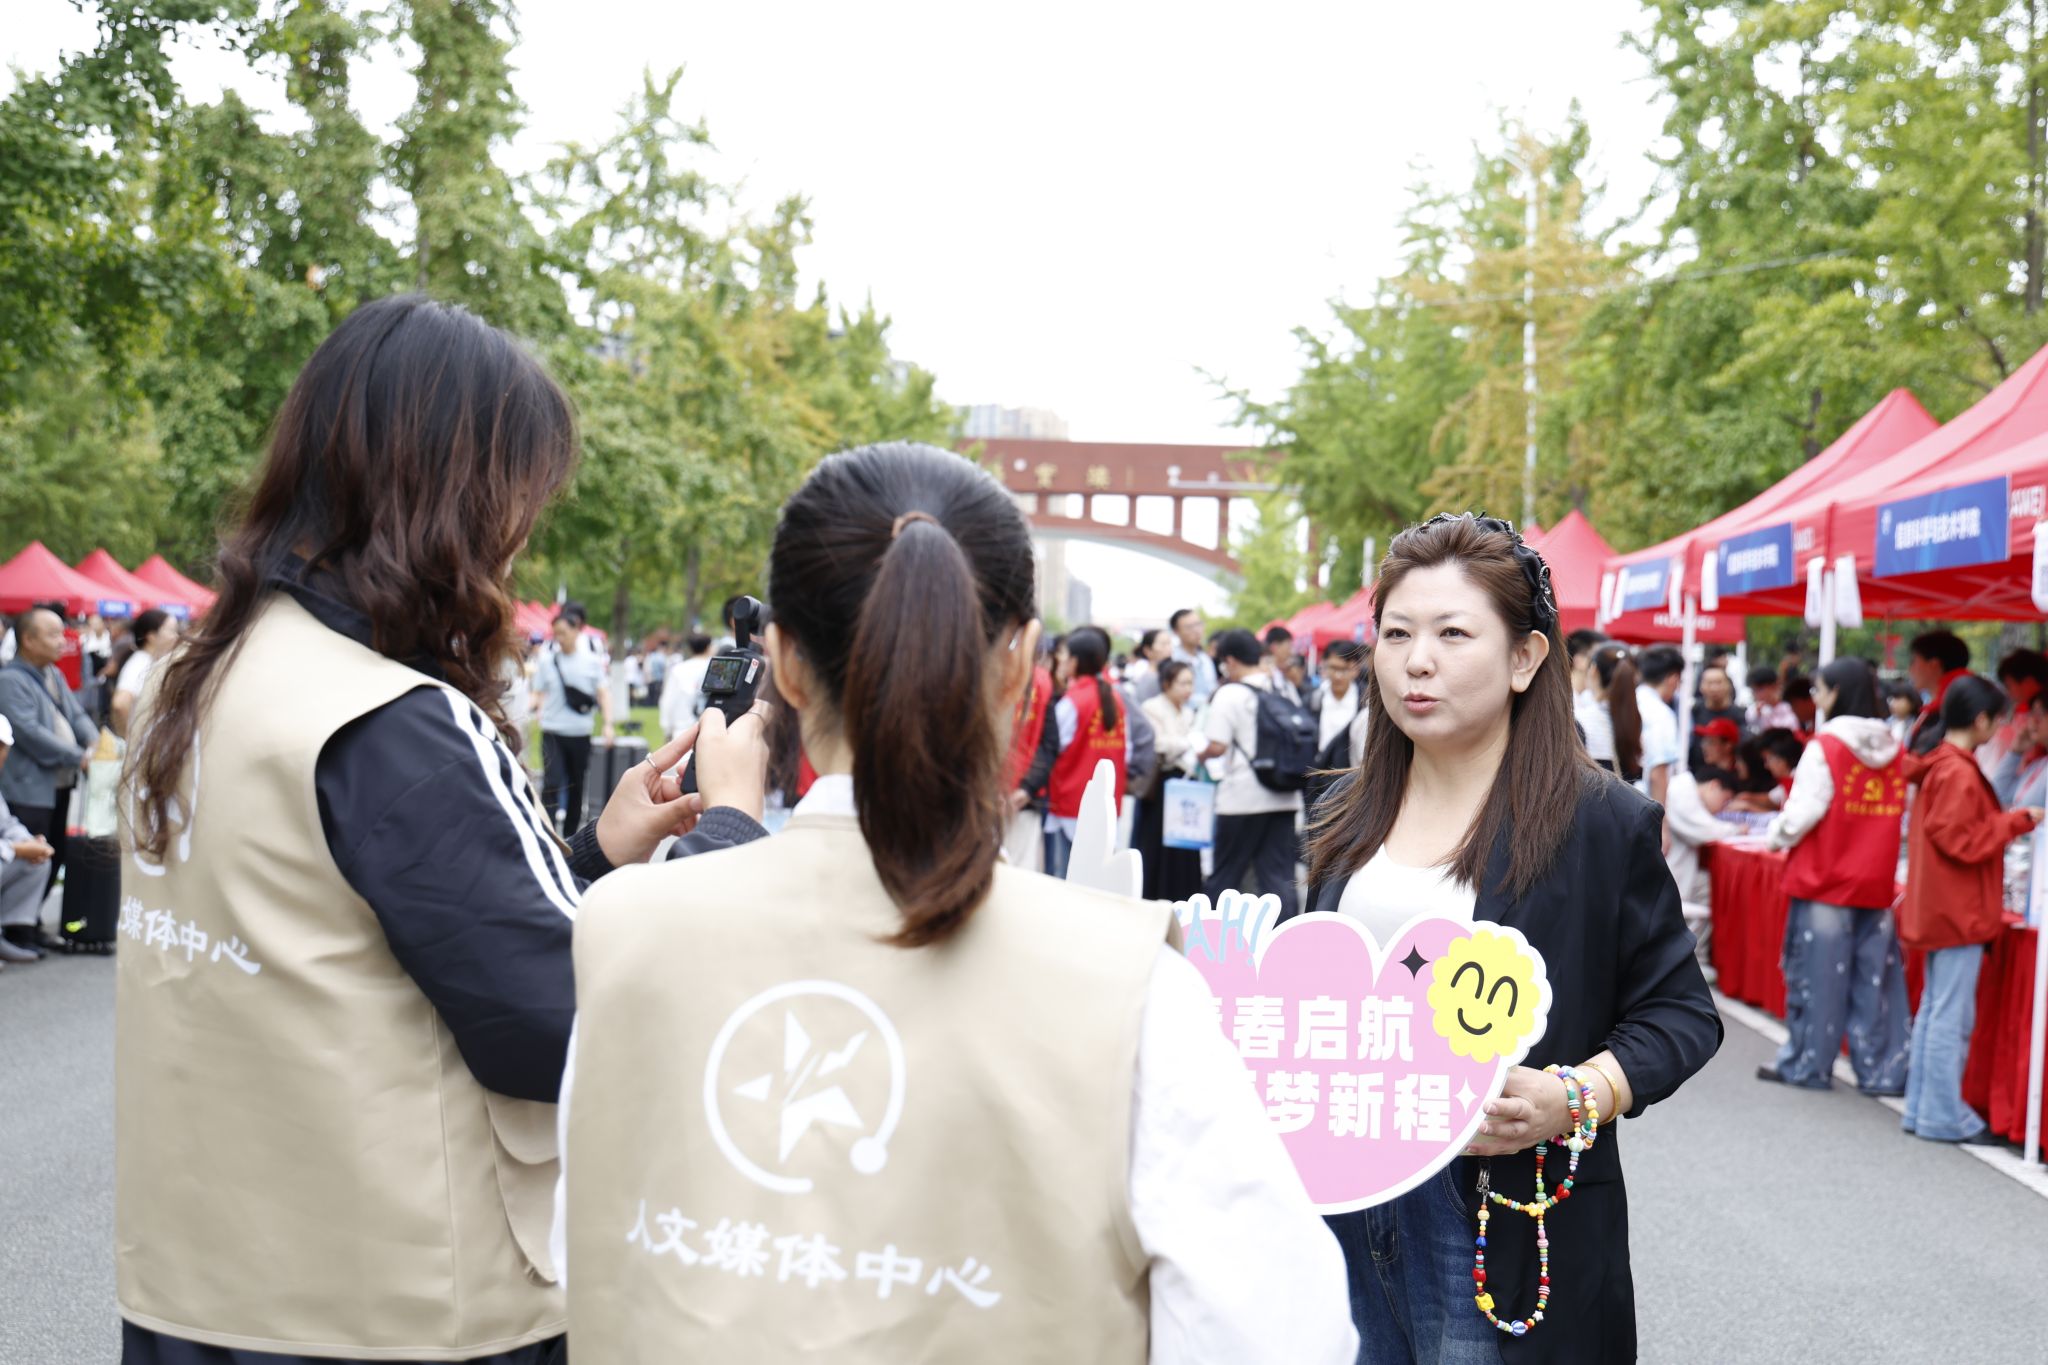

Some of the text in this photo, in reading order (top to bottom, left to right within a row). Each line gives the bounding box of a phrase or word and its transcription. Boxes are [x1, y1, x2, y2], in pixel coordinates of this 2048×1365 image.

[117, 895, 262, 975] 媒体中心
[1174, 897, 1271, 966] AH!
[1212, 995, 1415, 1062] 春启航
[1248, 1069, 1452, 1143] 梦新程
